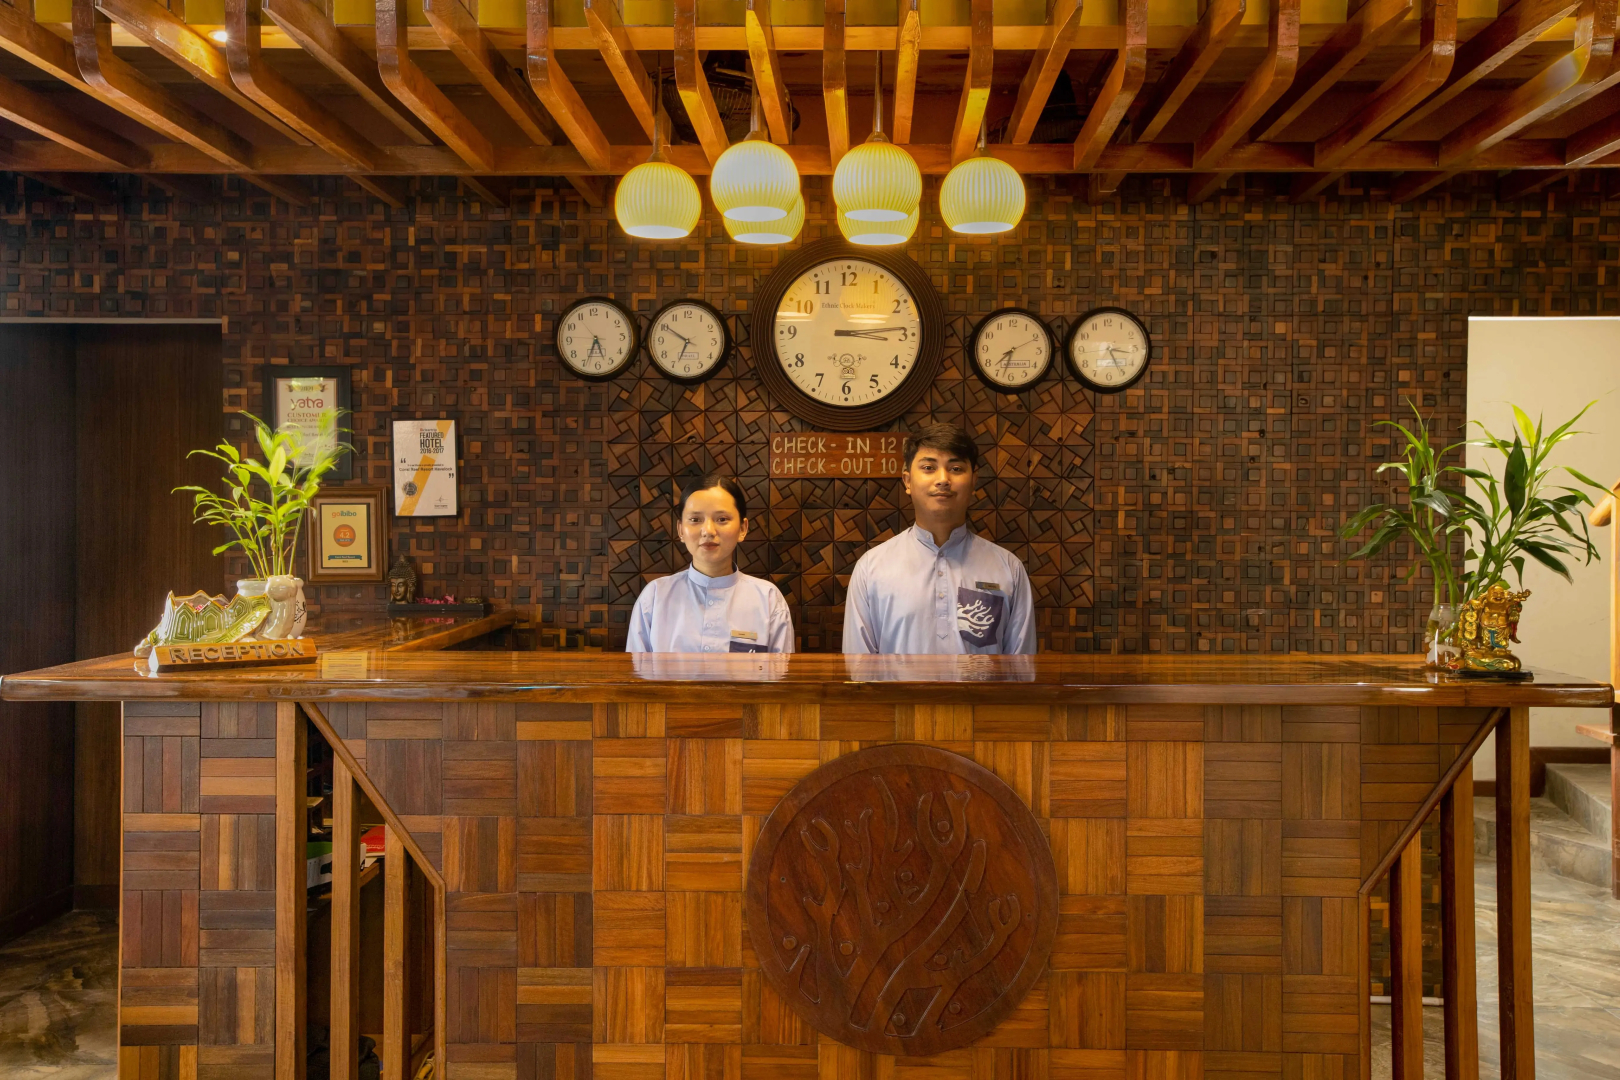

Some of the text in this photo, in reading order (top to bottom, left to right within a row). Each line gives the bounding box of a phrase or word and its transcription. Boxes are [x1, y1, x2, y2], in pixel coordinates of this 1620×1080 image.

[840, 272, 858, 286] 12
[814, 280, 830, 295] 11
[873, 280, 879, 294] 1
[796, 300, 814, 314] 10
[892, 299, 901, 314] 2
[590, 308, 598, 316] 12
[684, 310, 692, 318] 12
[672, 314, 678, 322] 11
[700, 314, 702, 322] 1
[1104, 318, 1112, 327] 12
[568, 323, 576, 331] 10
[614, 319, 620, 328] 2
[660, 323, 668, 331] 10
[707, 324, 713, 332] 2
[997, 322, 1002, 330] 11
[1009, 319, 1017, 328] 12
[1025, 323, 1028, 331] 1
[1092, 322, 1098, 331] 11
[1120, 322, 1122, 330] 1
[619, 332, 626, 341] 3
[787, 325, 797, 340] 9
[898, 327, 908, 342] 3
[985, 331, 994, 340] 10
[1032, 333, 1039, 341] 2
[1080, 332, 1089, 341] 10
[1128, 331, 1134, 340] 2
[566, 336, 572, 345] 9
[658, 336, 664, 345] 9
[711, 338, 718, 346] 3
[616, 347, 623, 355] 4
[982, 344, 989, 354] 9
[1036, 347, 1042, 355] 3
[1078, 345, 1085, 354] 9
[1132, 344, 1138, 353] 3
[570, 350, 577, 358] 8
[660, 350, 667, 359] 8
[706, 352, 713, 360] 4
[582, 359, 586, 367] 7
[608, 357, 614, 365] 5
[795, 353, 805, 367] 8
[889, 355, 899, 369] 4
[985, 358, 991, 367] 8
[1082, 360, 1088, 368] 8
[594, 361, 602, 370] 6
[684, 364, 690, 373] 6
[696, 361, 703, 369] 5
[1031, 361, 1038, 369] 4
[1021, 370, 1028, 378] 5
[1092, 370, 1097, 378] 7
[1106, 372, 1112, 381] 6
[1119, 368, 1126, 376] 5
[814, 373, 824, 387] 7
[869, 374, 879, 388] 5
[1008, 373, 1014, 382] 6
[842, 380, 851, 395] 6
[290, 396, 324, 410] yatra
[420, 439, 444, 448] HOTEL
[846, 437, 870, 454] IN
[880, 437, 896, 454] 12
[880, 458, 897, 474] 10
[169, 642, 304, 663] RECEPTION
